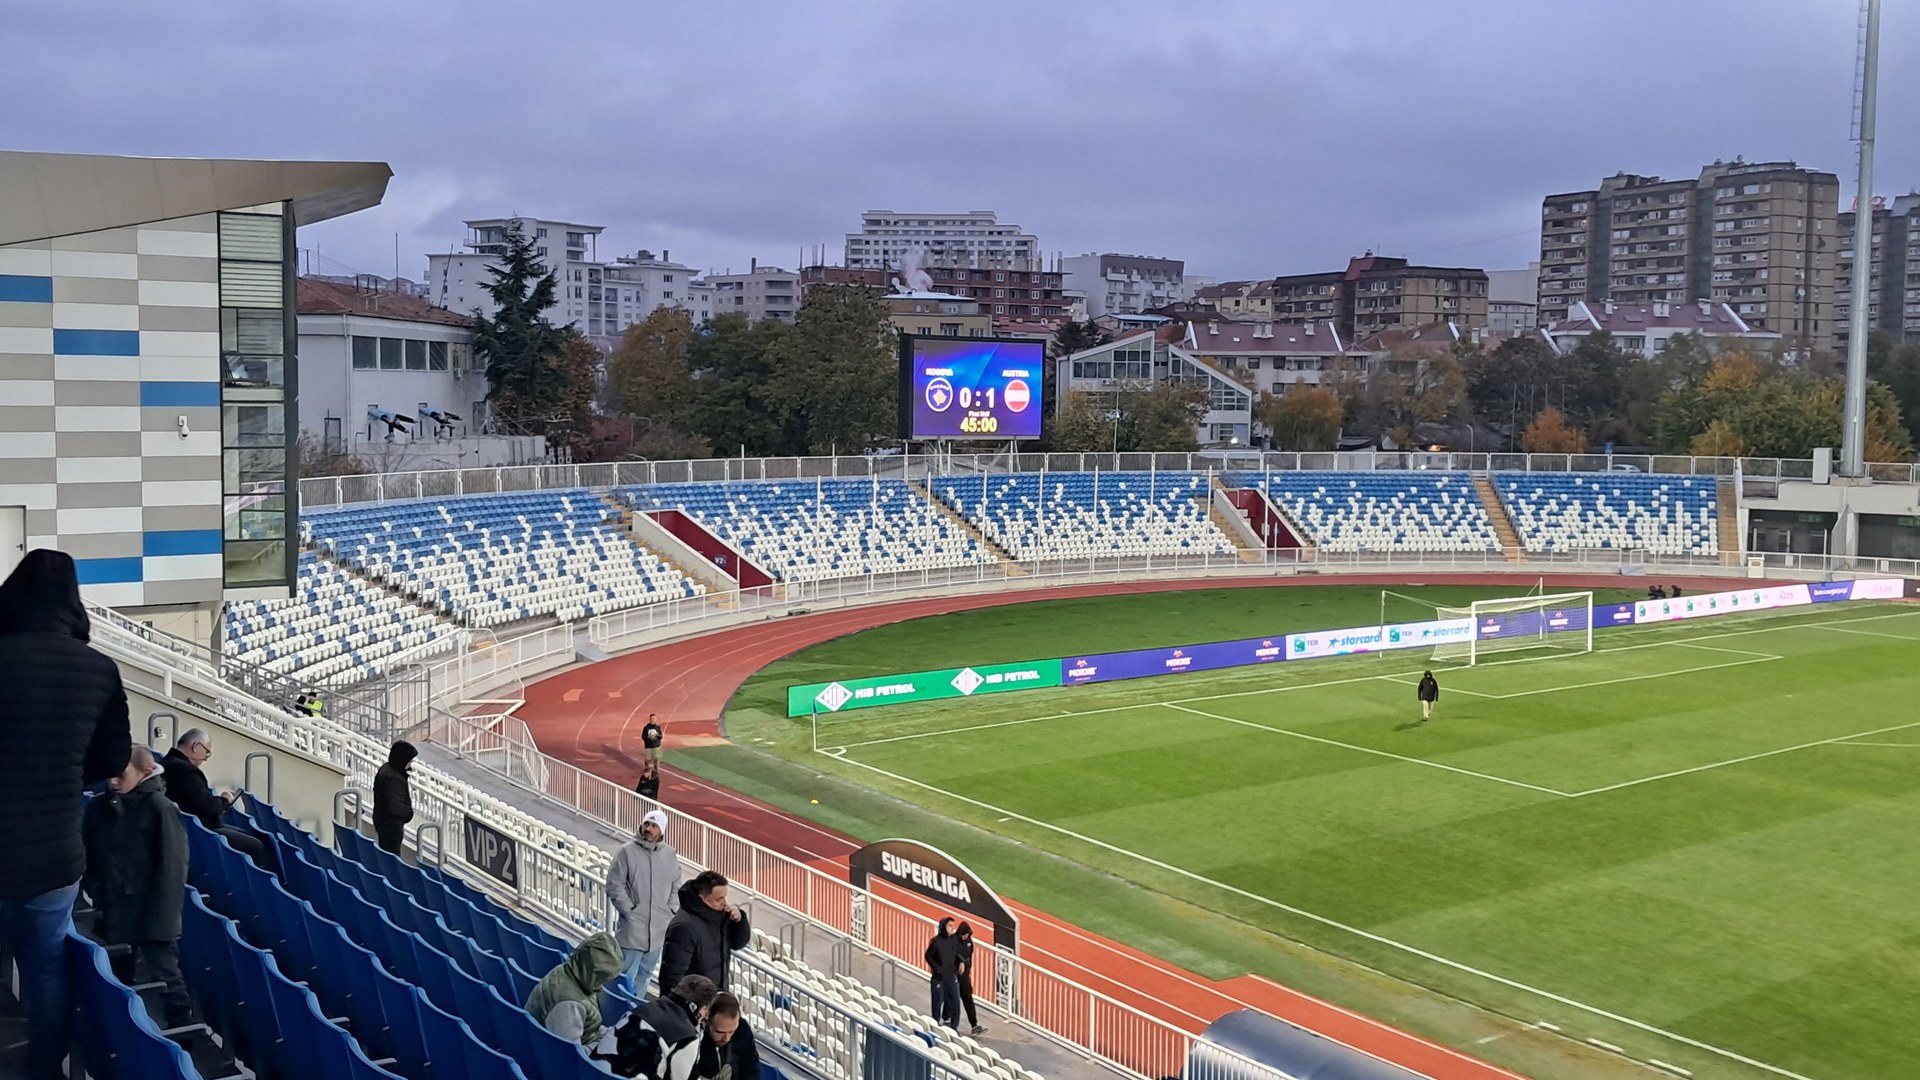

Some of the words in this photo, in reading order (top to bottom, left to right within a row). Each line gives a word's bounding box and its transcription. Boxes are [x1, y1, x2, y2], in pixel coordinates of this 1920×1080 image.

[1002, 369, 1029, 377] AUSTRIA
[960, 387, 971, 408] 0
[986, 388, 994, 408] 1
[960, 417, 997, 432] 45:00
[1433, 623, 1470, 637] starcard
[1341, 631, 1382, 646] starcard
[1004, 670, 1041, 682] PETROL
[855, 687, 874, 699] HIB
[876, 683, 916, 696] PETROL
[468, 822, 498, 869] VIP
[501, 840, 513, 881] 2
[881, 850, 971, 903] SUPERLIGA
